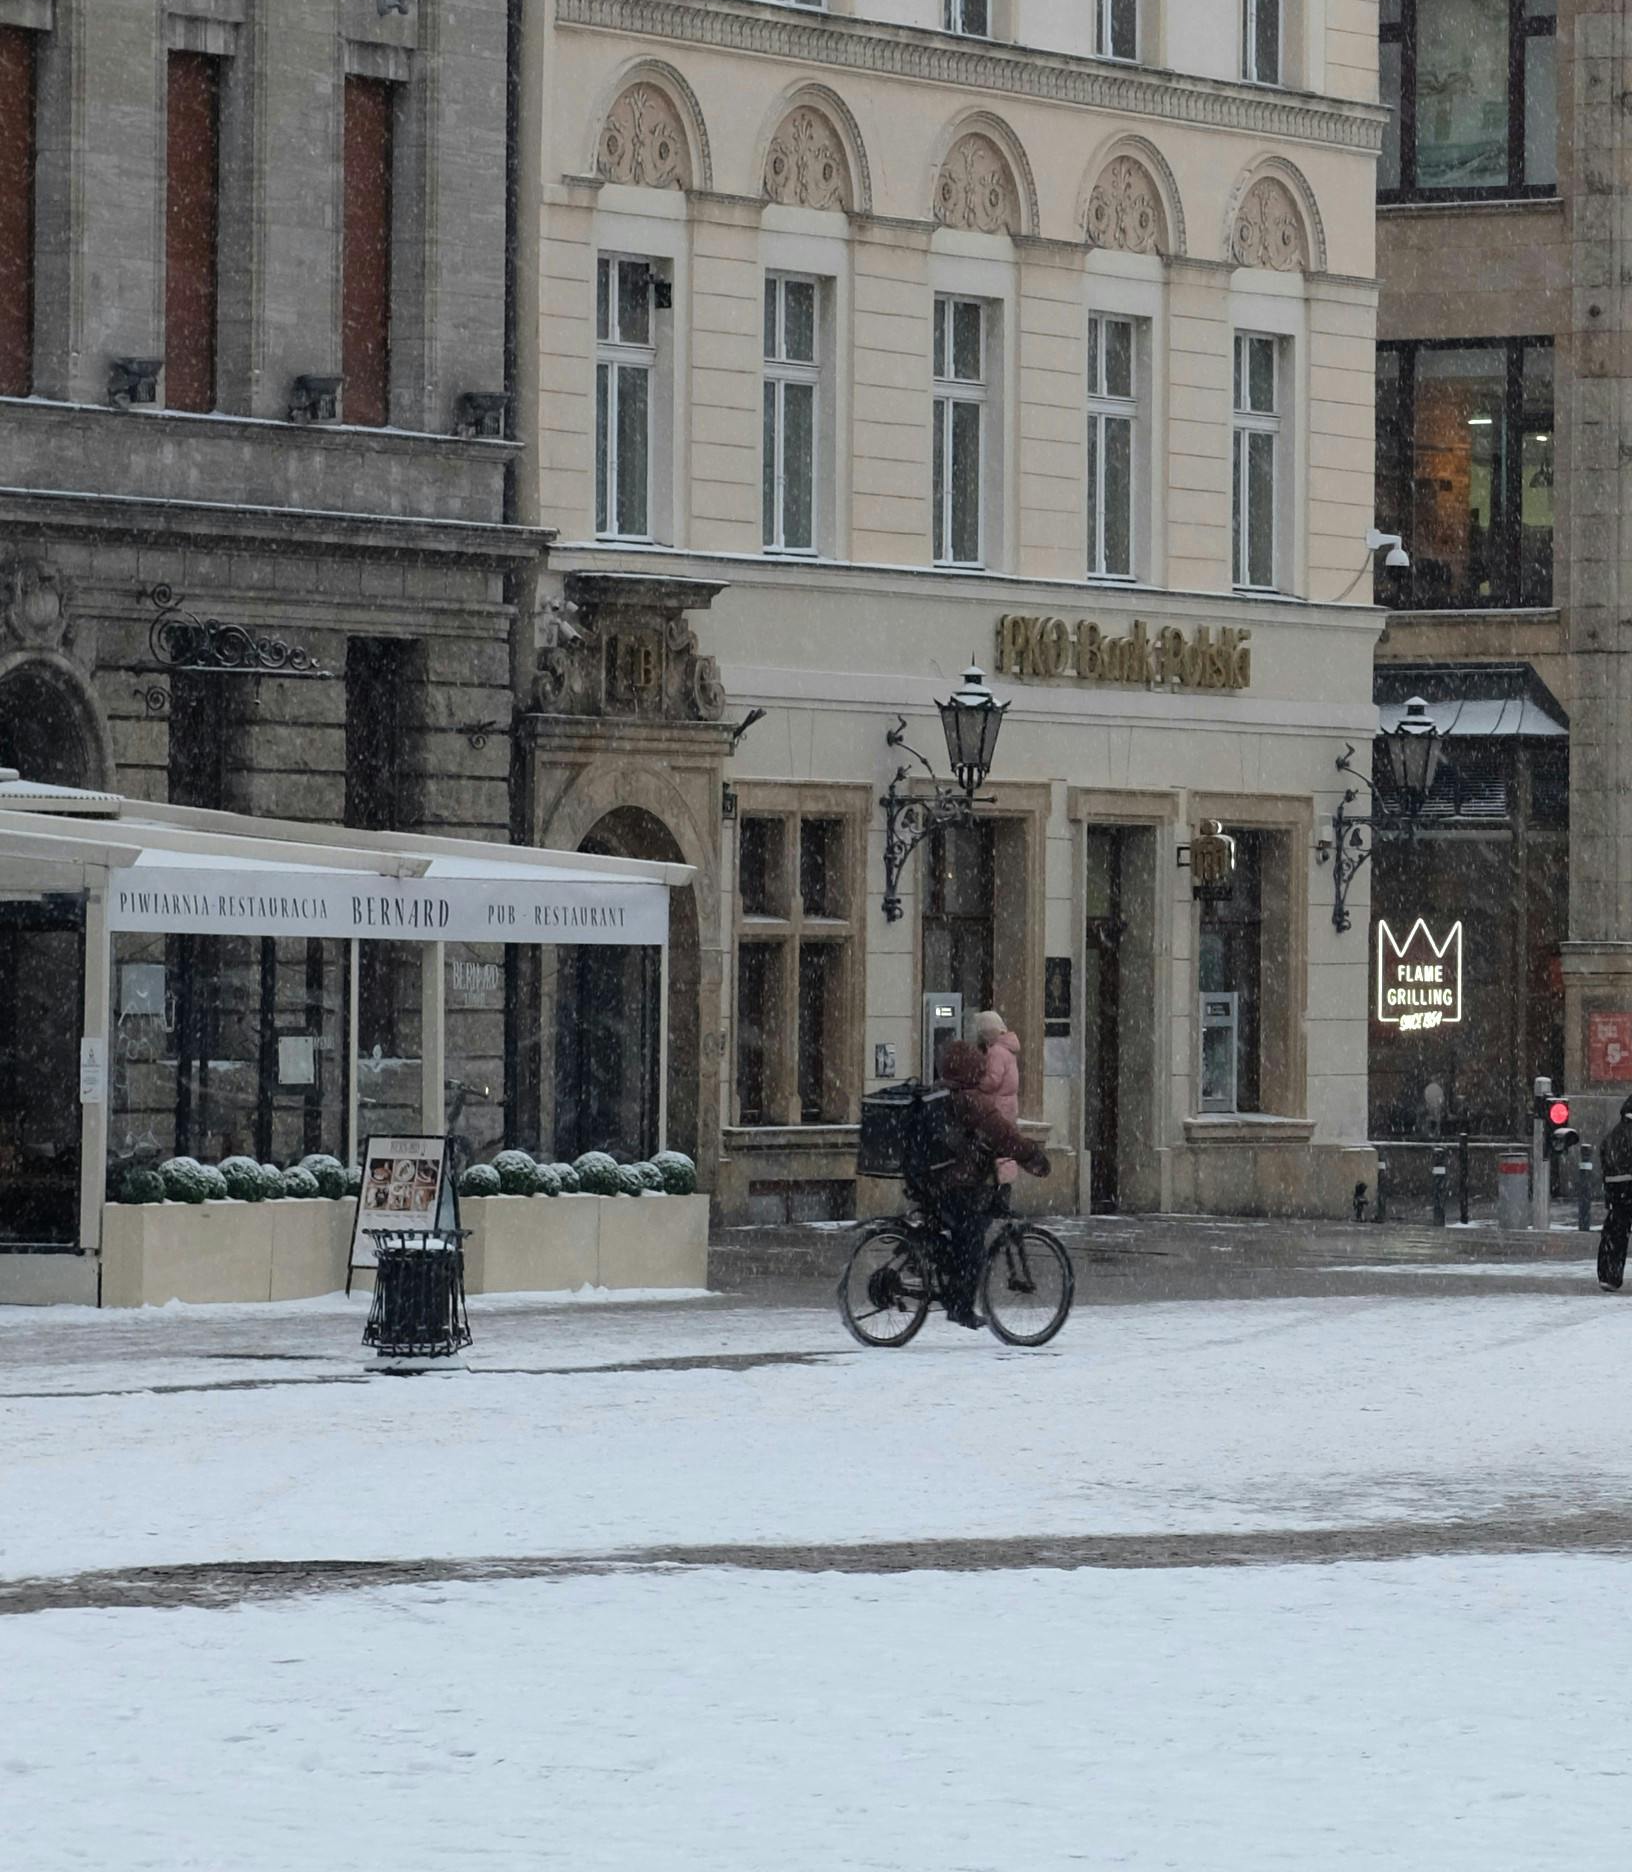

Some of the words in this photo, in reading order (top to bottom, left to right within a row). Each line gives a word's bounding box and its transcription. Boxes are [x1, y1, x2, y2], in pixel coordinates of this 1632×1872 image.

[995, 614, 1069, 677] PKO
[352, 896, 449, 928] BERNARD
[488, 905, 515, 925] PUB
[534, 906, 625, 927] RESTAURANT
[1397, 965, 1443, 982] FLAME
[1387, 988, 1453, 1006] GRILLING
